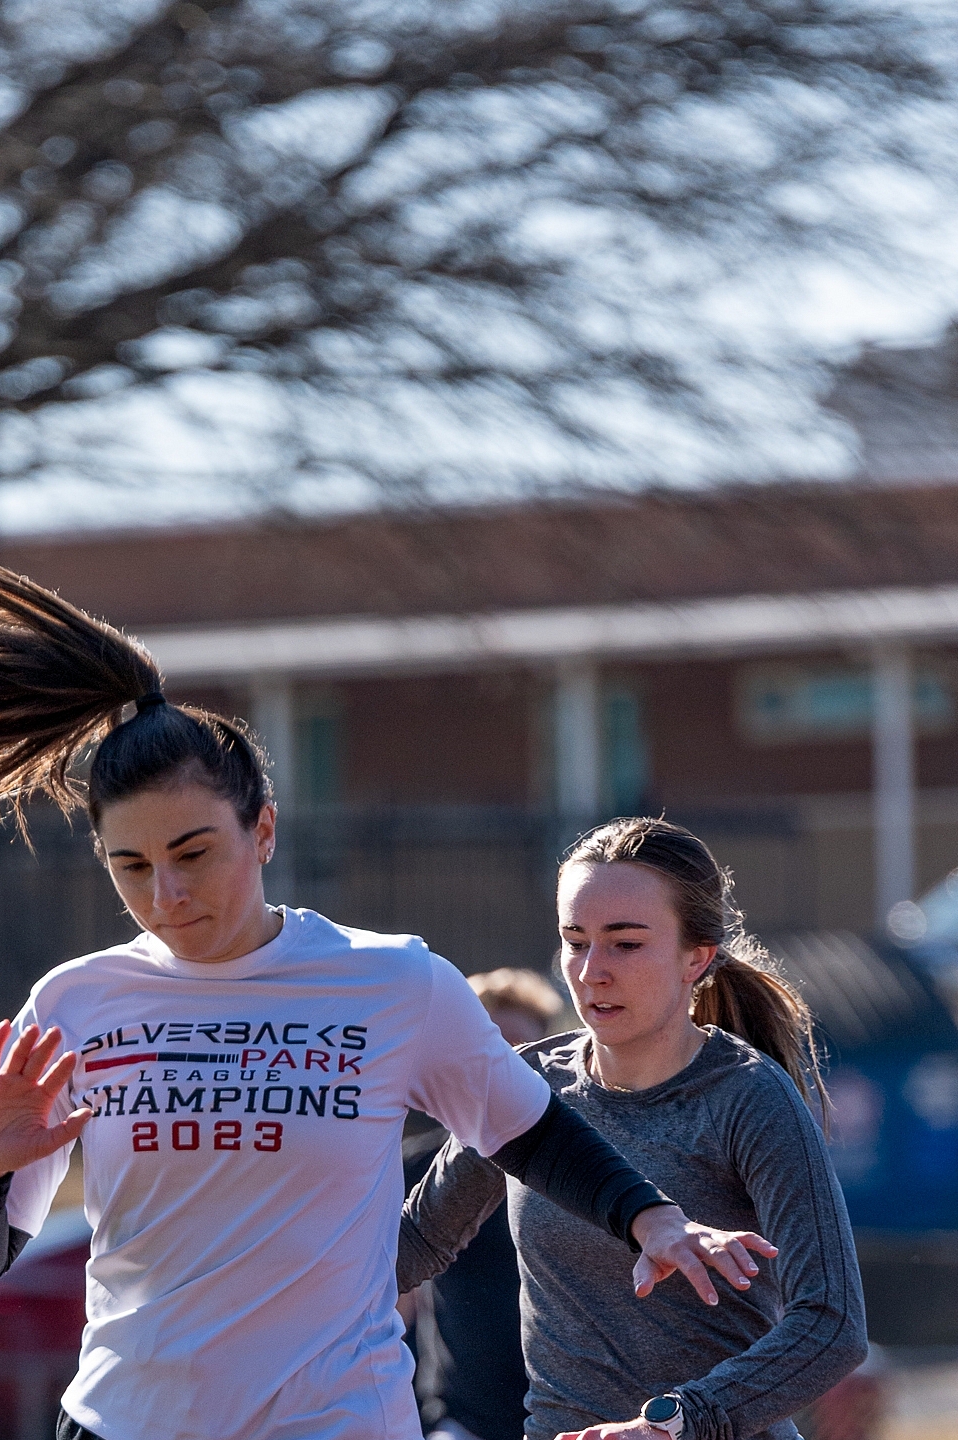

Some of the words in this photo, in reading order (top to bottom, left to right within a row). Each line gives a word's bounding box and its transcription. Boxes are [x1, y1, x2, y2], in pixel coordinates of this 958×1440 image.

[81, 1021, 368, 1055] SILVERBACKS
[138, 1069, 282, 1082] LEAGUE
[240, 1049, 363, 1075] PARK
[82, 1085, 362, 1120] CHAMPIONS
[132, 1120, 284, 1152] 2023
